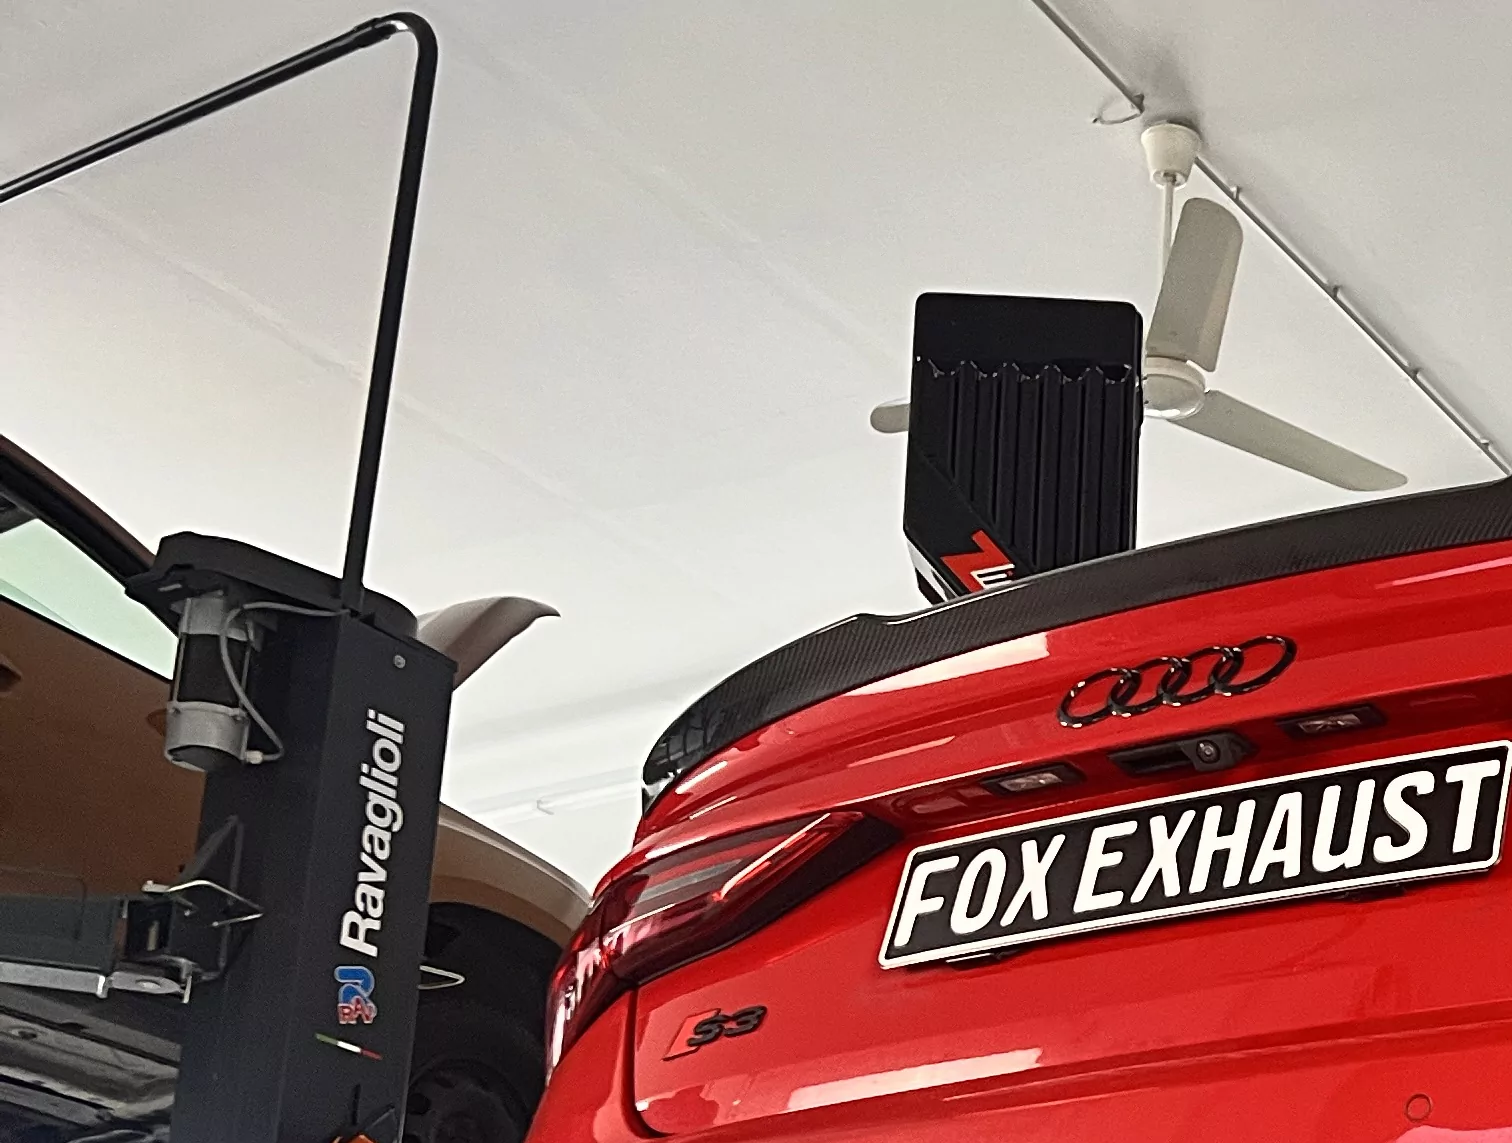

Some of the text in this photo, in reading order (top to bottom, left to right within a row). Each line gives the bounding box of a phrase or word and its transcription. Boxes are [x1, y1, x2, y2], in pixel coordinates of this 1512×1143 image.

[339, 708, 405, 958] Ravaglioli
[893, 759, 1500, 948] FOX EXHAUST
[686, 1005, 768, 1048] S3
